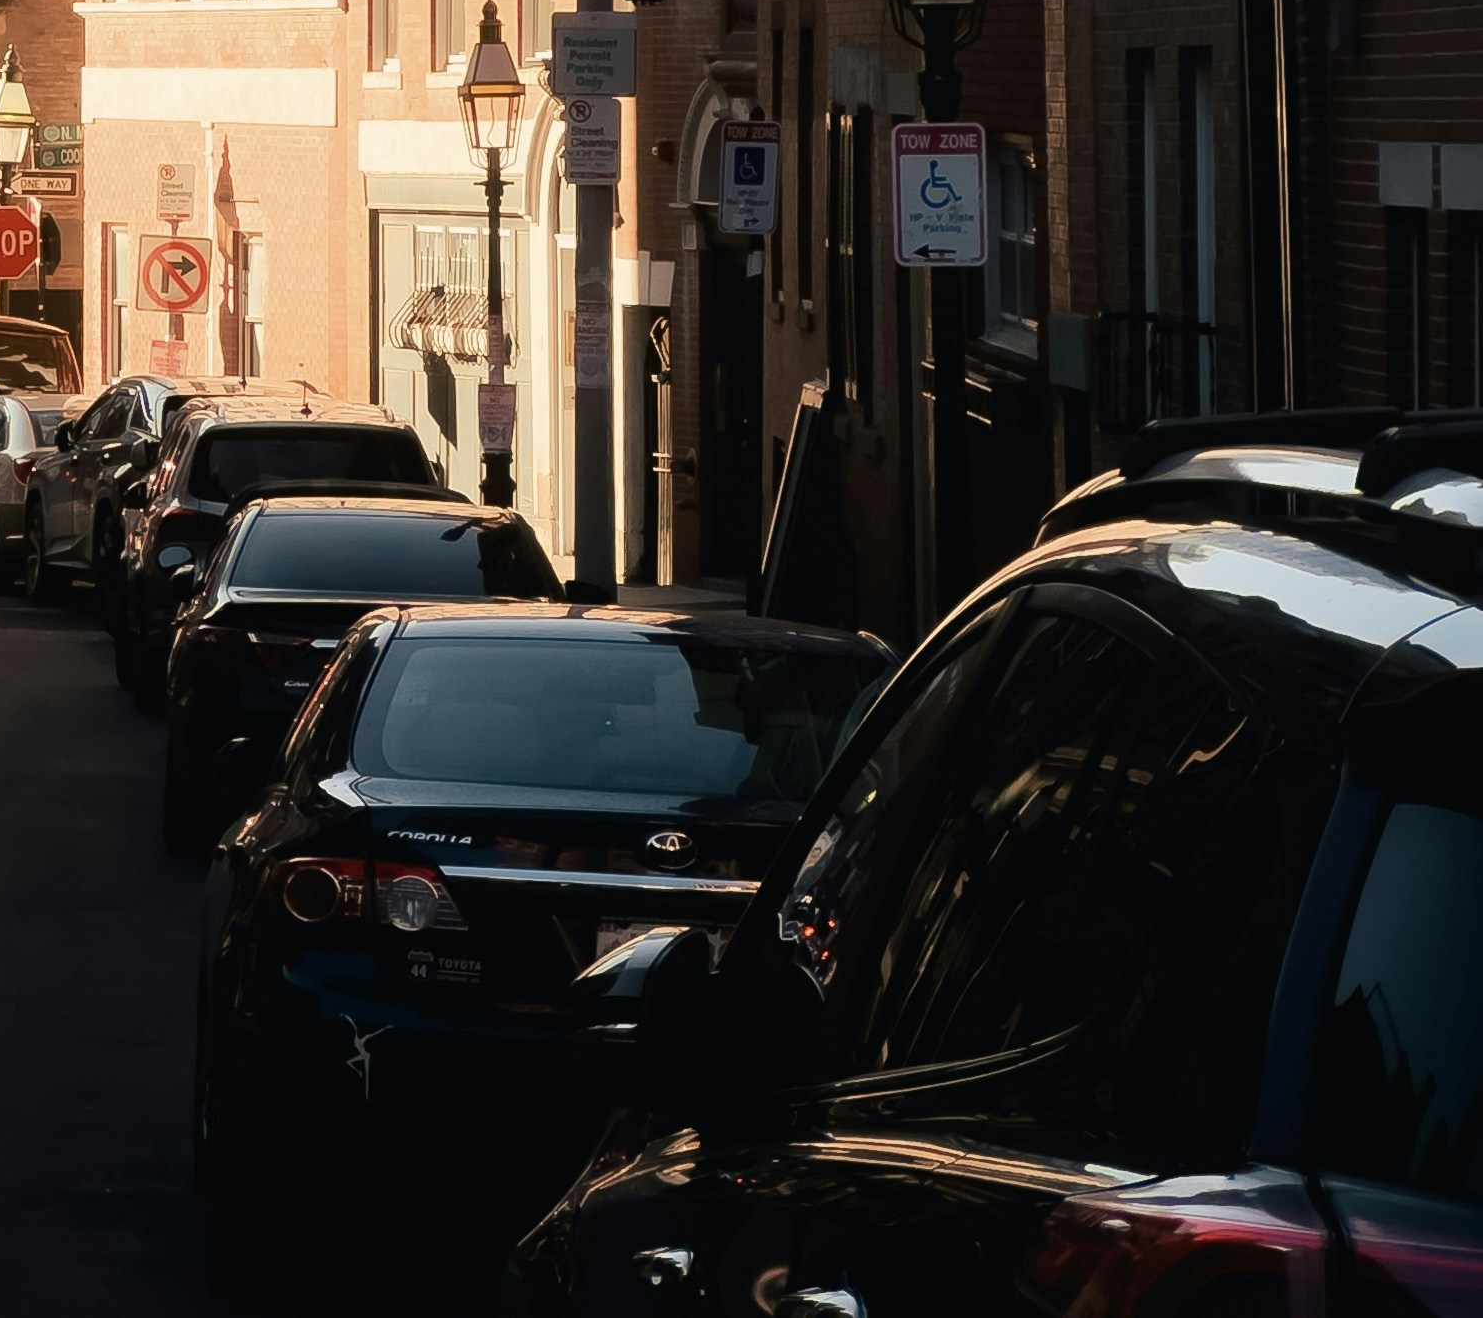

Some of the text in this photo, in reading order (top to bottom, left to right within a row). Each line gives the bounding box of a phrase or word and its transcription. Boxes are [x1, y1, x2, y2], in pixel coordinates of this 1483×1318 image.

[570, 50, 611, 61] Permit
[575, 76, 604, 89] Only
[727, 126, 778, 139] TOW ZONE
[900, 134, 978, 149] TOW ZONE
[61, 148, 82, 164] COO
[20, 179, 68, 189] ONE WAY
[410, 963, 427, 978] 44
[438, 957, 482, 971] TOYOTA
